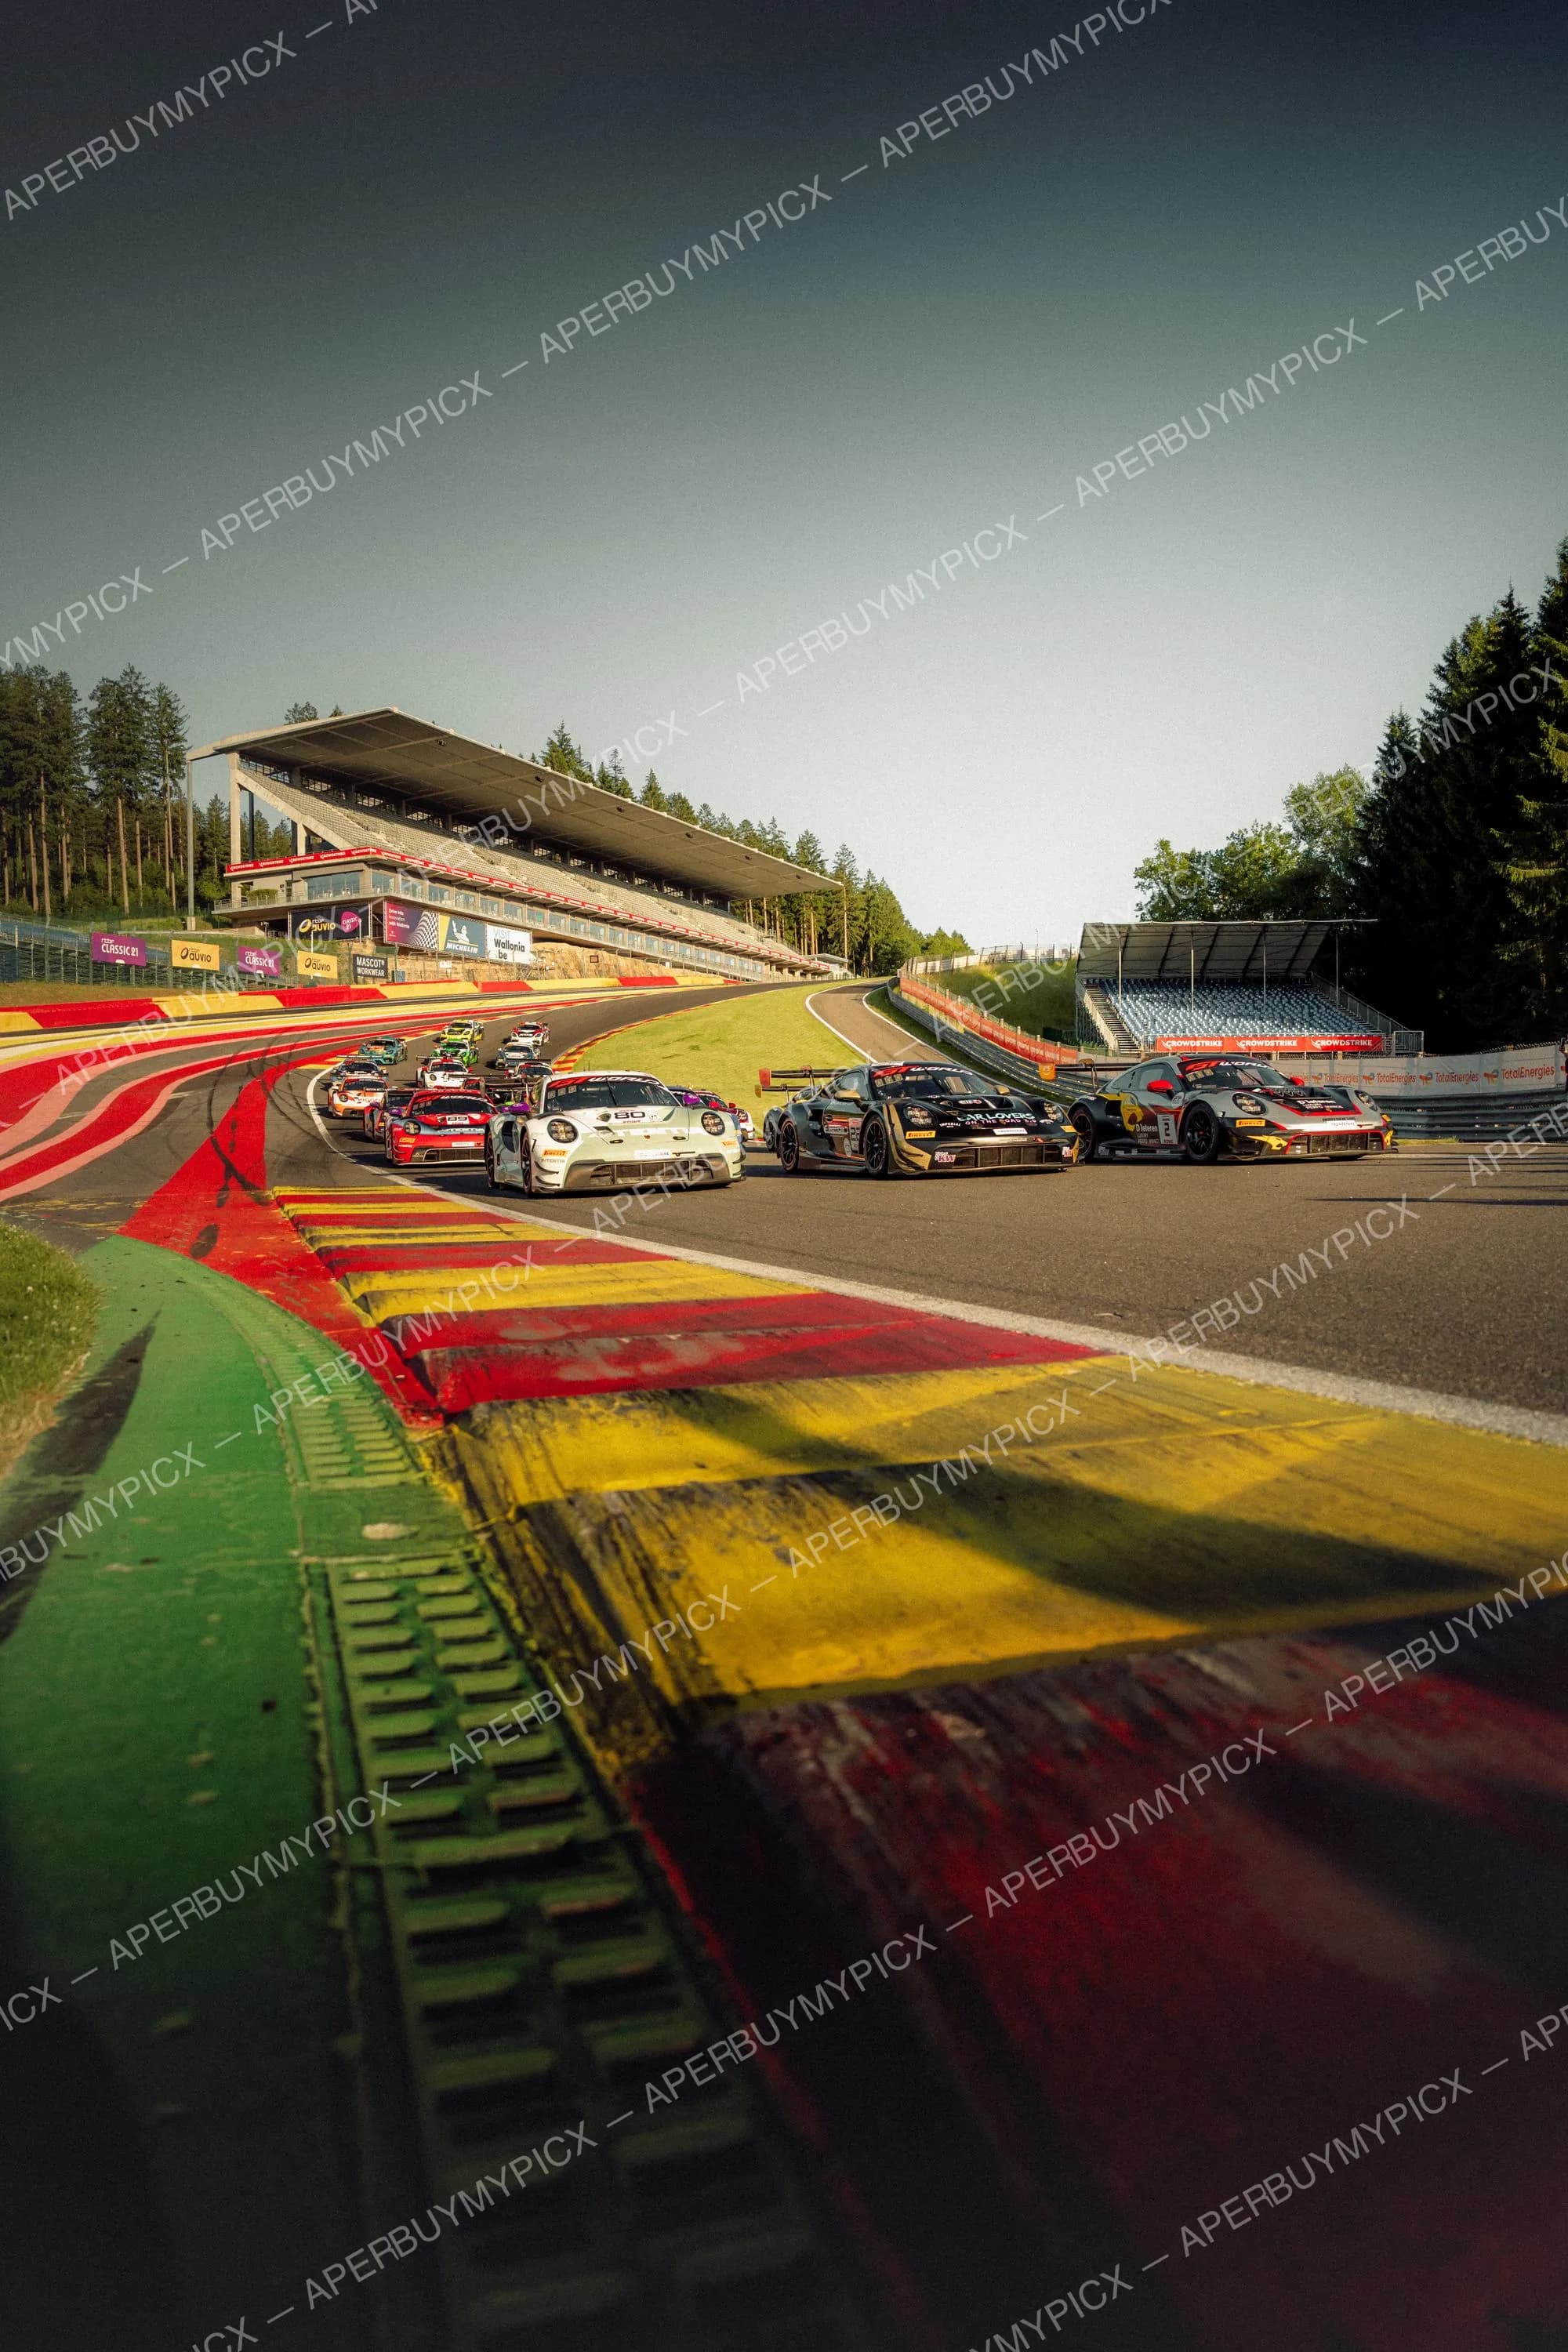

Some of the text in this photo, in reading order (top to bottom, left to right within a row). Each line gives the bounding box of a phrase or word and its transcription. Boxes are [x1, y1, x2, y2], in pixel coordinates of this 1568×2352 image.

[493, 927, 510, 938] VISIT
[101, 943, 138, 956] CLASSIC 21
[446, 942, 478, 954] MICHELIN
[494, 938, 525, 953] Wallonia
[245, 956, 274, 967] CLASSIC 21
[357, 967, 385, 977] WORKWEAR
[1435, 1071, 1479, 1085] TotalEnergies
[1501, 1065, 1555, 1080] TotalEnergies
[1376, 1073, 1416, 1088] TotalEnergies
[614, 1111, 646, 1120] 80
[1163, 1122, 1171, 1137] 2
